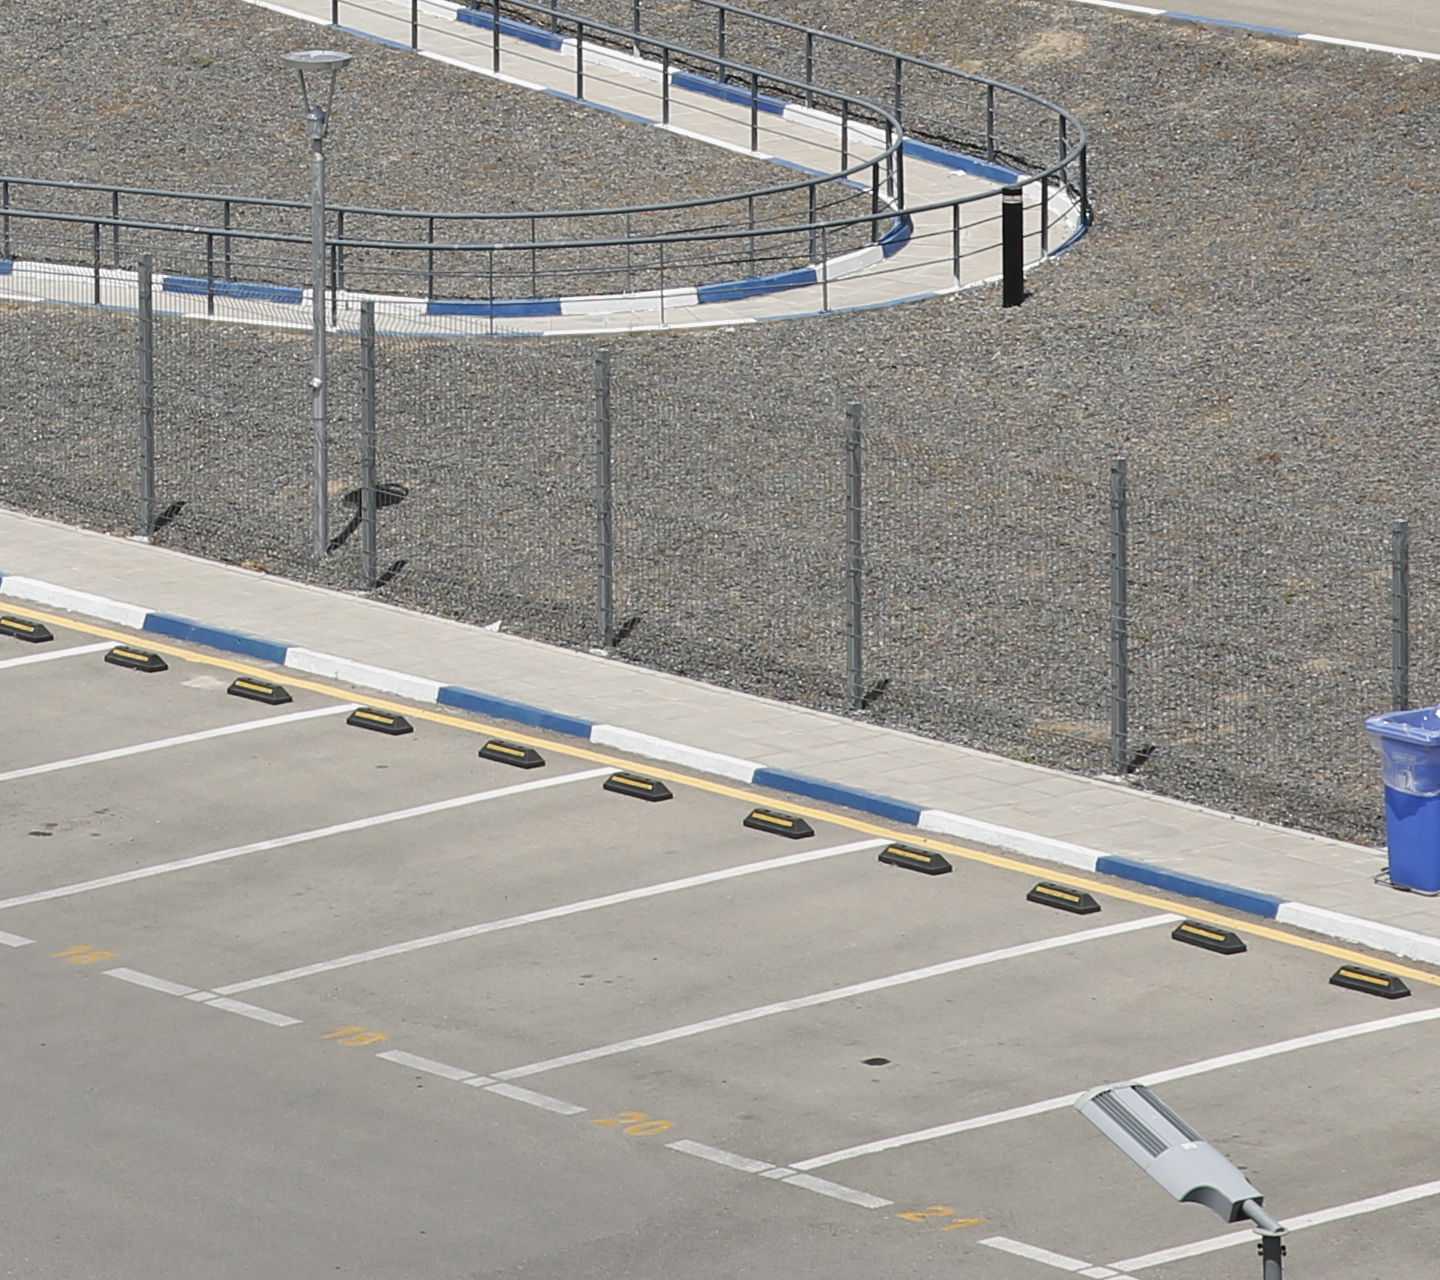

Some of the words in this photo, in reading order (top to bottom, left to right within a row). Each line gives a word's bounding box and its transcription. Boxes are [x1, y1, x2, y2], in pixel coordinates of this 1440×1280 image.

[51, 945, 117, 965] 18
[322, 1025, 389, 1046] 19
[589, 1111, 676, 1136] 20
[896, 1205, 988, 1232] 21
